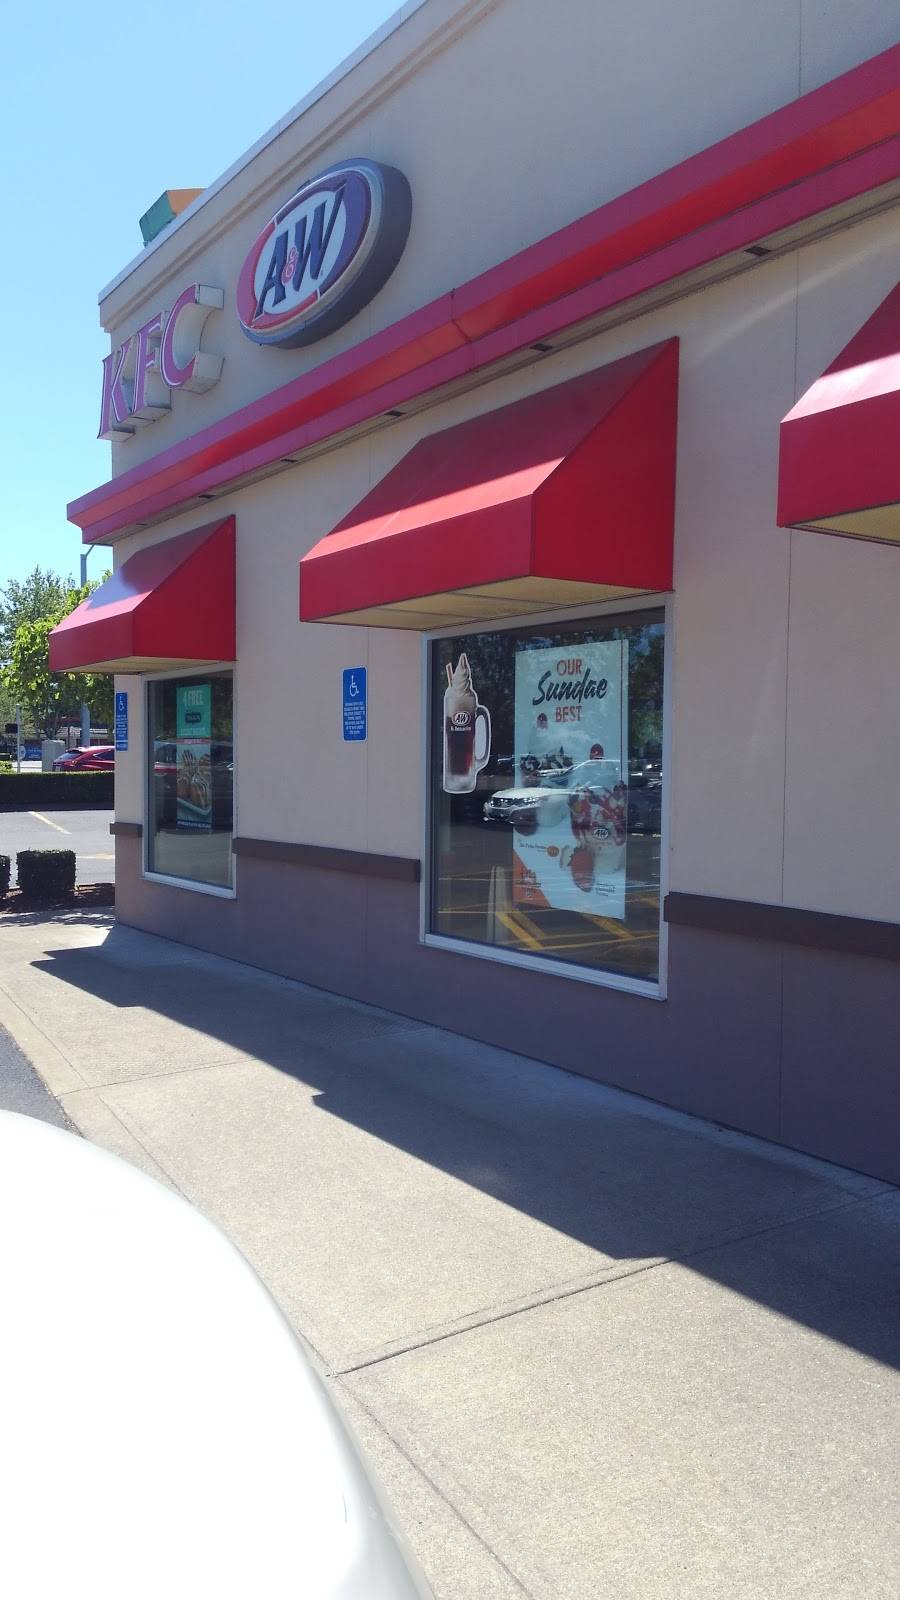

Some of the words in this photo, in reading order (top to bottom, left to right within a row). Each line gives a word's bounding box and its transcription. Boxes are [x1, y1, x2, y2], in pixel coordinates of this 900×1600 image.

[254, 179, 348, 319] A&W
[97, 283, 212, 437] KFC
[532, 667, 608, 706] Sundae
[556, 658, 583, 676] OUR
[555, 705, 583, 723] BEST
